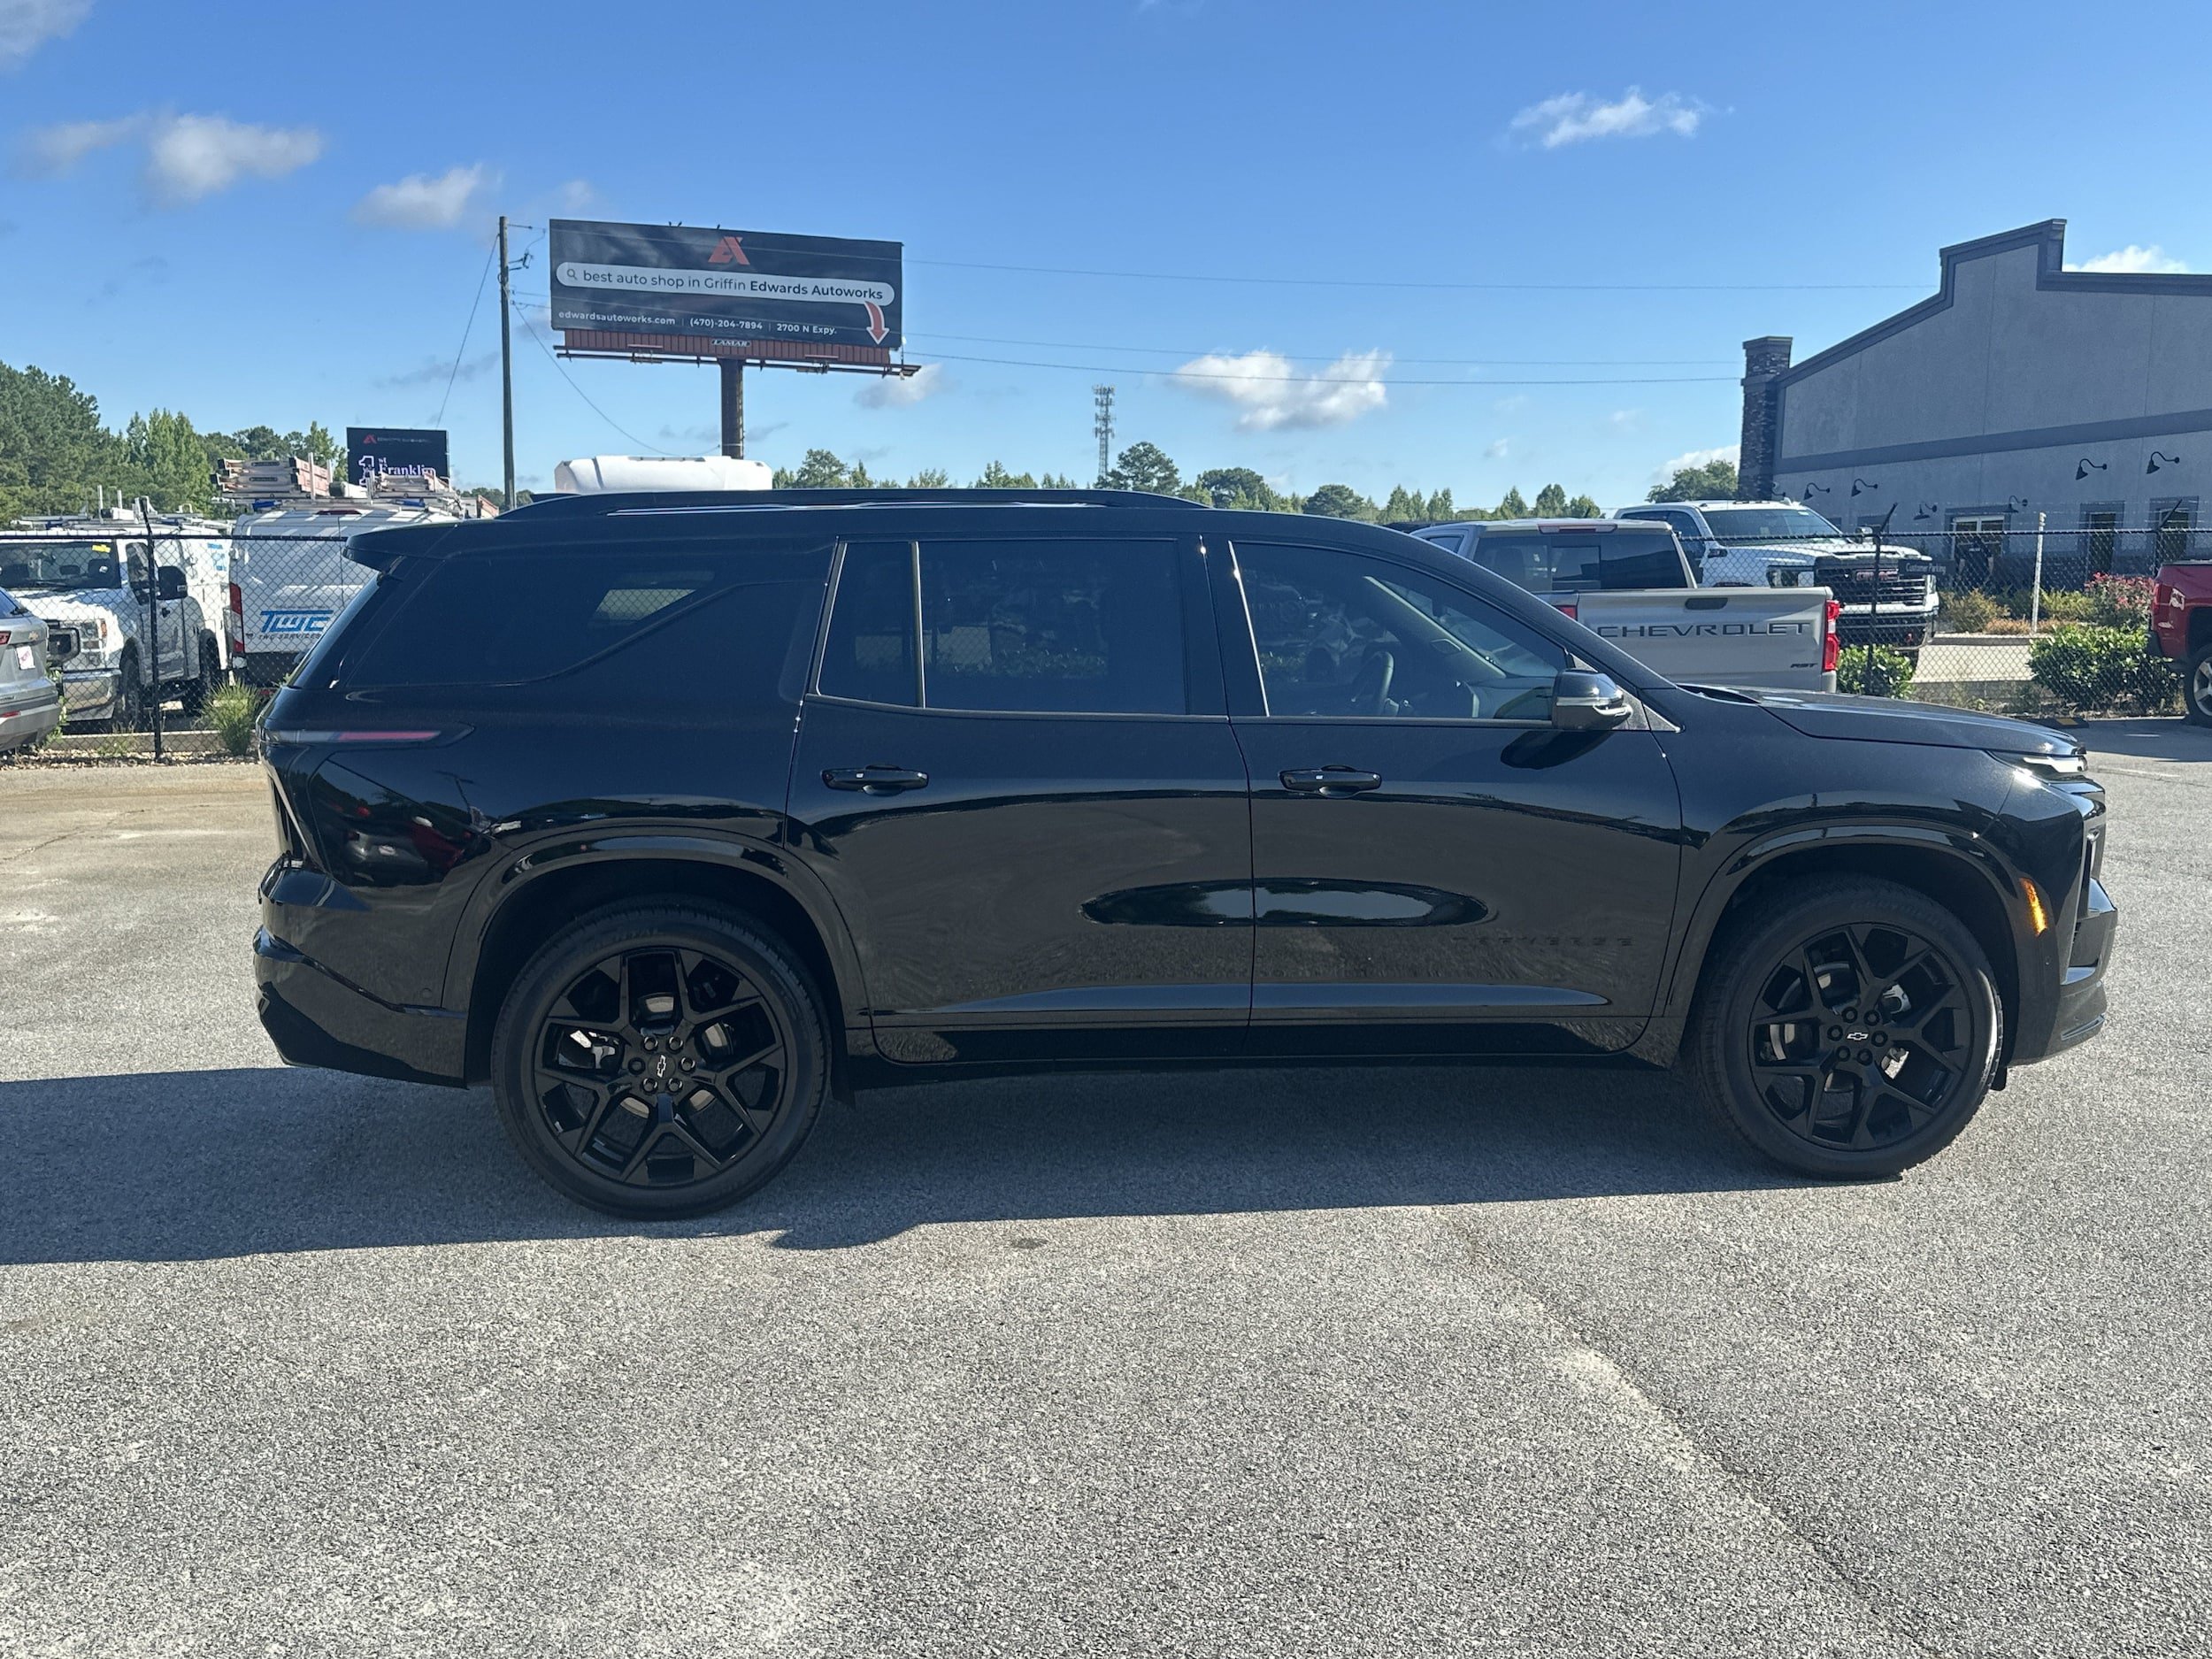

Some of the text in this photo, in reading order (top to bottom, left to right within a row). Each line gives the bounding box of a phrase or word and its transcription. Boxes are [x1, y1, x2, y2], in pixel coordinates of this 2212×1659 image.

[583, 269, 883, 300] best auto shop in Griffin Edwards Autoworks
[558, 311, 676, 325] edwardsautoworks.com
[689, 319, 763, 329] (470)-204-7894
[777, 323, 800, 333] 2700
[812, 326, 837, 336] Expy.
[1905, 562, 1947, 575] Customer Parking
[260, 610, 334, 633] TWC
[1597, 622, 1810, 637] CHEVROLET
